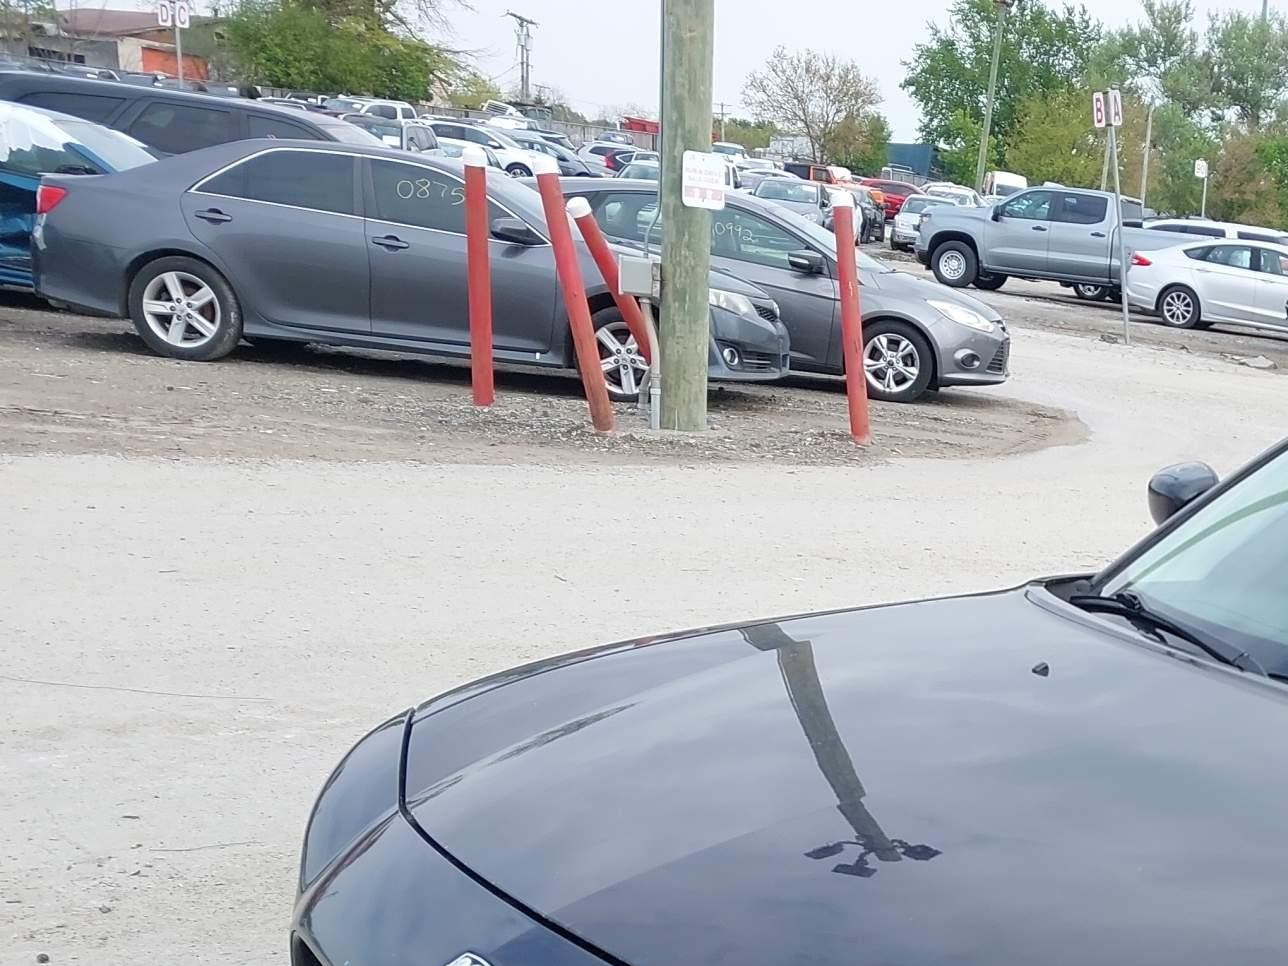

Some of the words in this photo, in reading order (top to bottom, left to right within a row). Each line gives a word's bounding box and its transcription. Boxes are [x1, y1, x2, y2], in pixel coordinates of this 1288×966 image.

[160, 3, 169, 23] D
[177, 5, 187, 25] C
[1095, 97, 1103, 123] B
[1113, 93, 1121, 123] A
